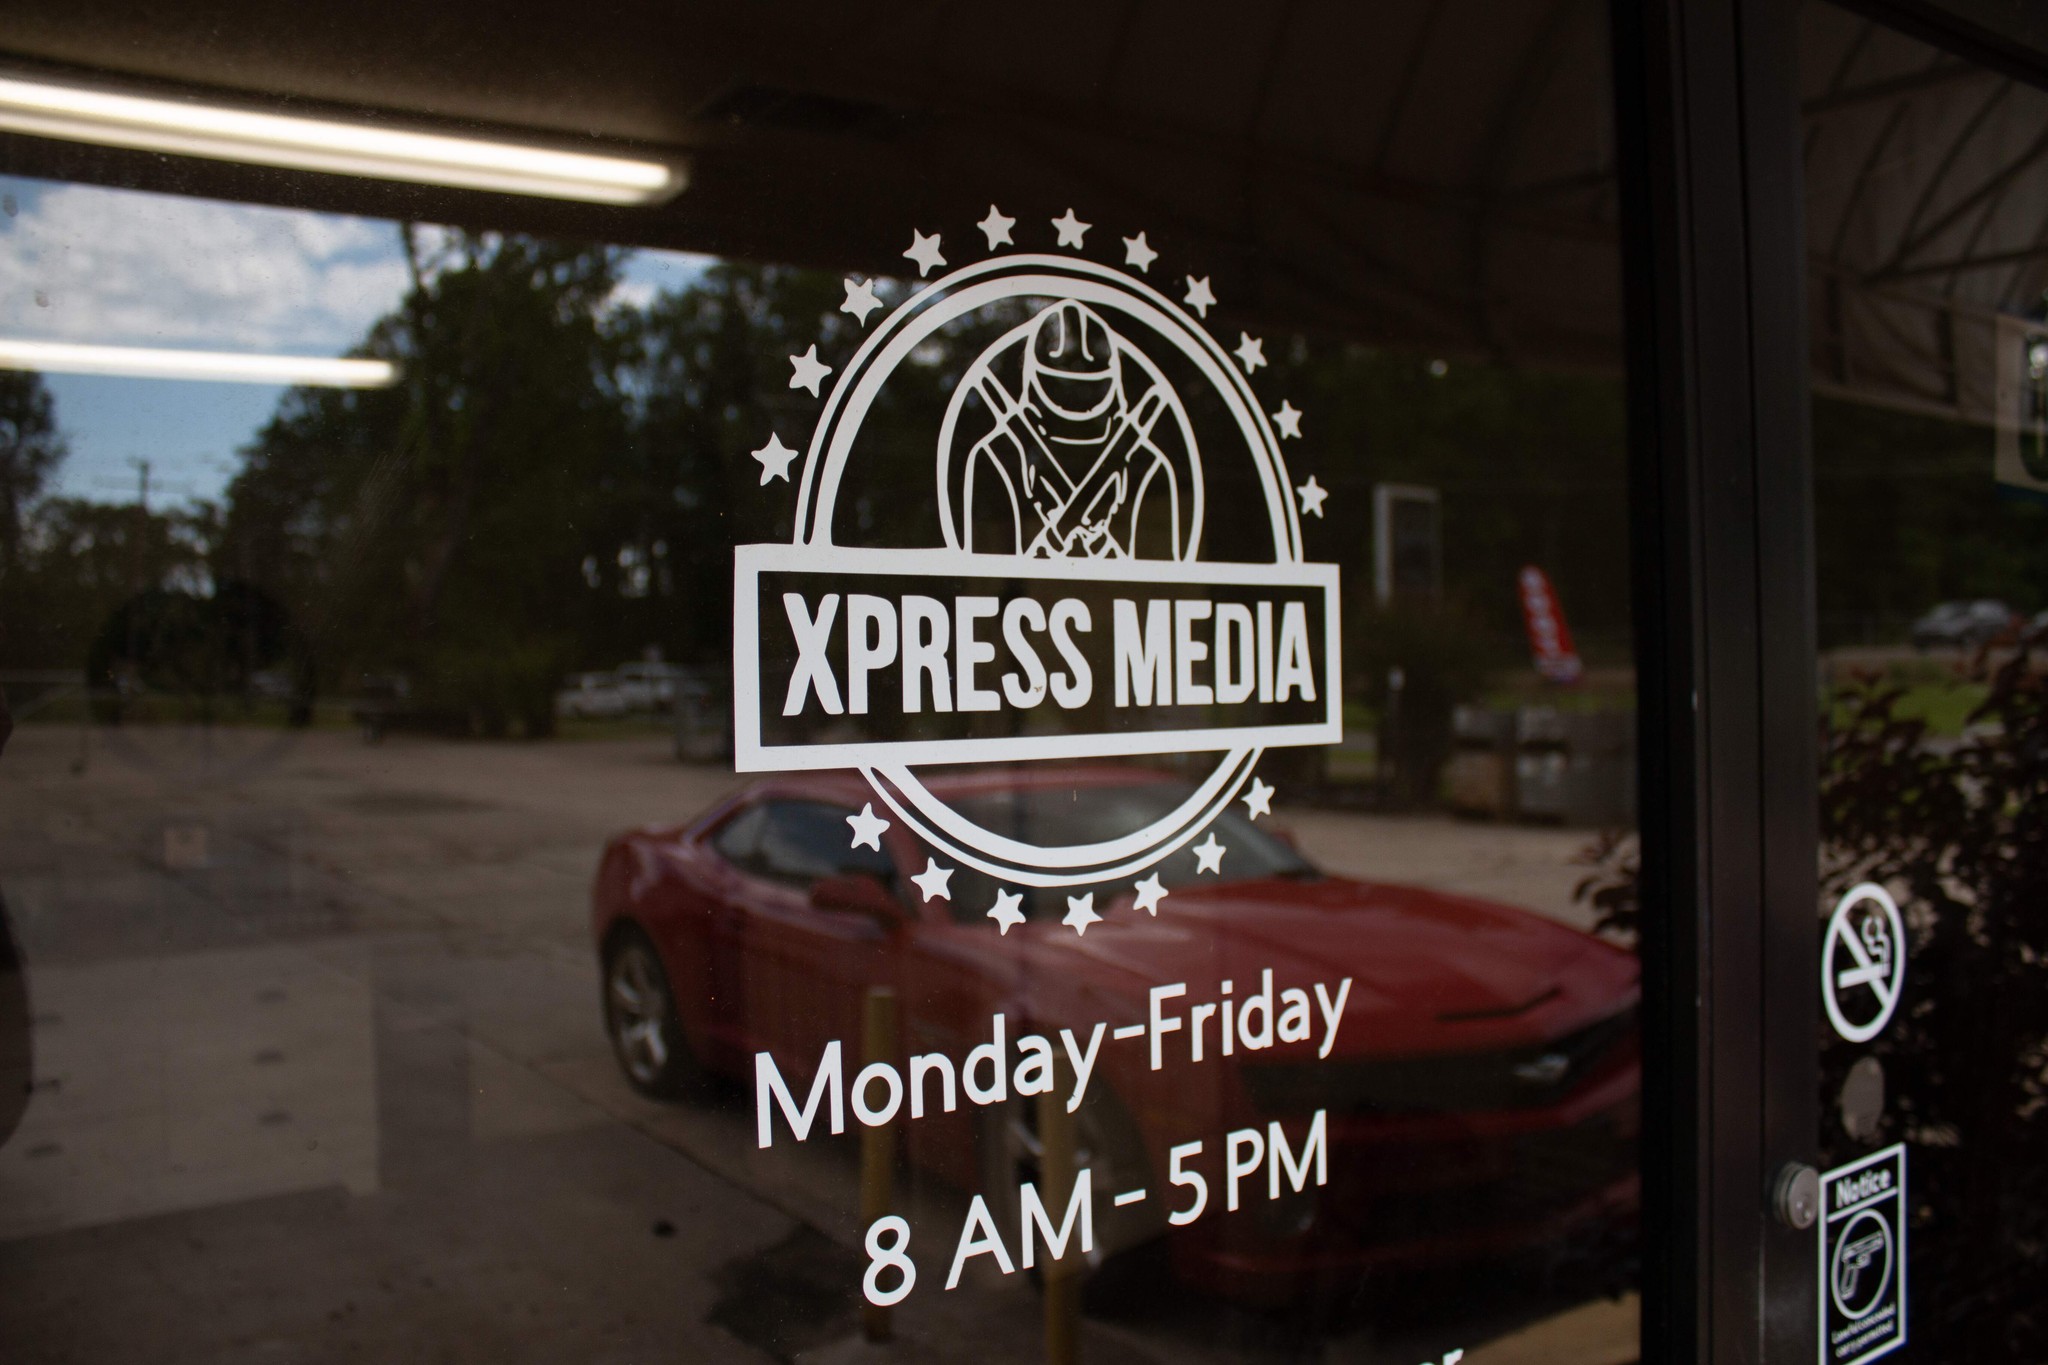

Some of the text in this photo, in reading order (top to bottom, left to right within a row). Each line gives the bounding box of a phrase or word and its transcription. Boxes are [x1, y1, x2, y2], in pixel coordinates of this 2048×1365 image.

[782, 592, 1317, 717] XPRESS MEDIA
[755, 968, 1353, 1149] Monday-Friday
[862, 1215, 917, 1307] 8
[945, 1168, 1093, 1290] AM
[1168, 1140, 1208, 1226] 5
[1226, 1109, 1328, 1213] PM
[1836, 1168, 1891, 1209] Notice
